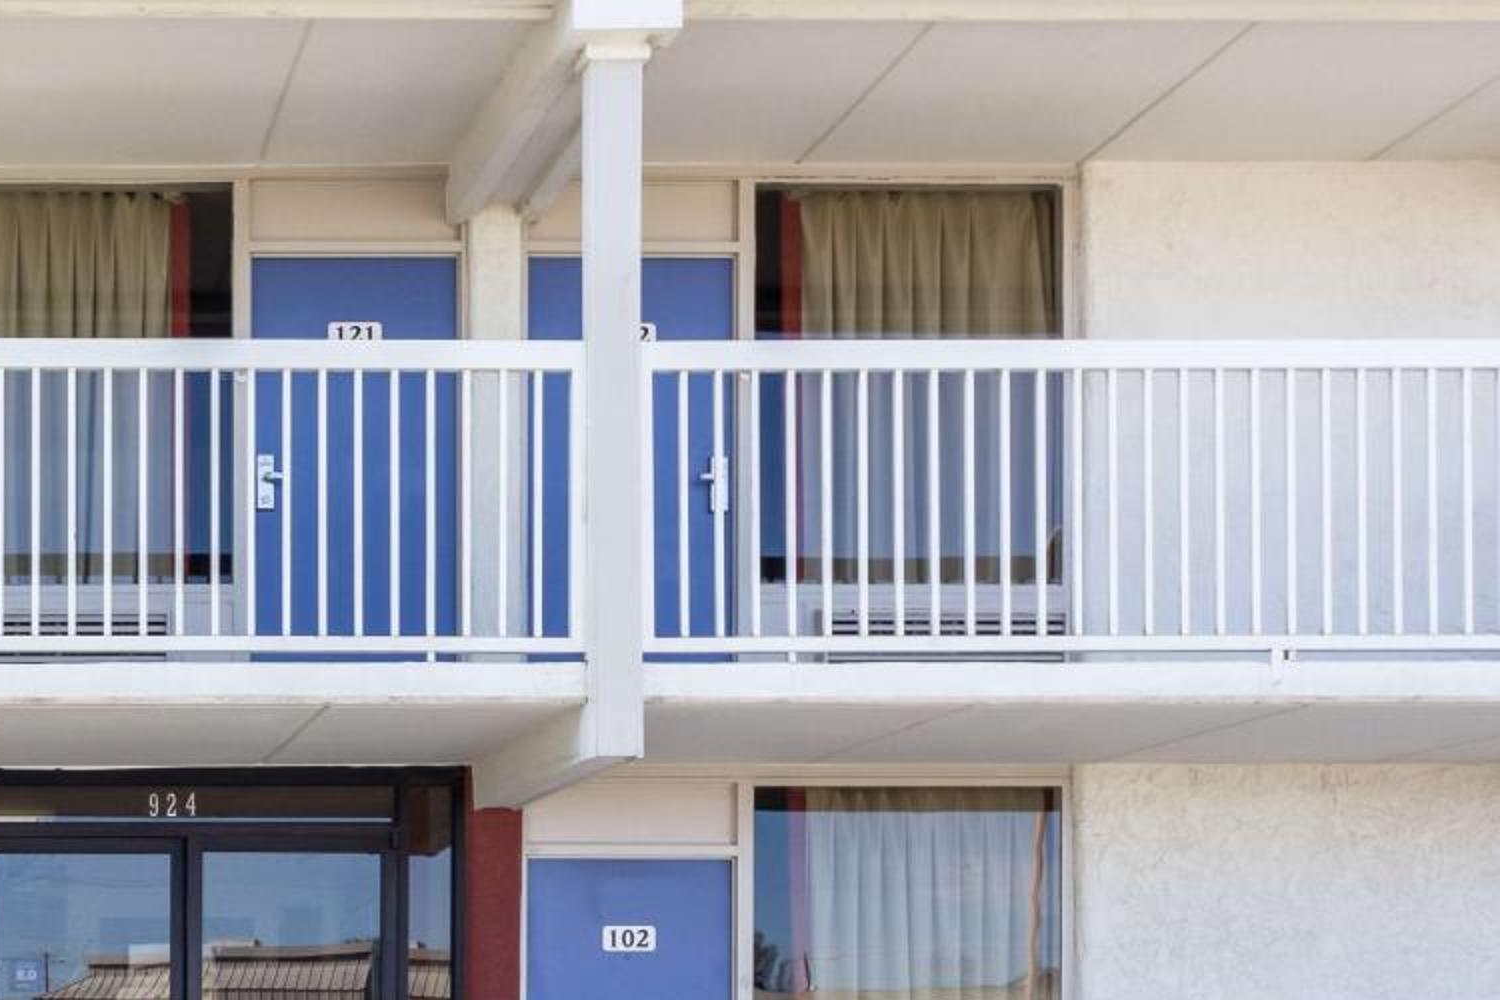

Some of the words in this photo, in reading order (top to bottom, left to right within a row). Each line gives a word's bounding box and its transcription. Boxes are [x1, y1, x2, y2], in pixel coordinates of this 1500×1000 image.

[336, 325, 373, 341] 121
[149, 792, 196, 817] 924
[610, 929, 649, 948] 102
